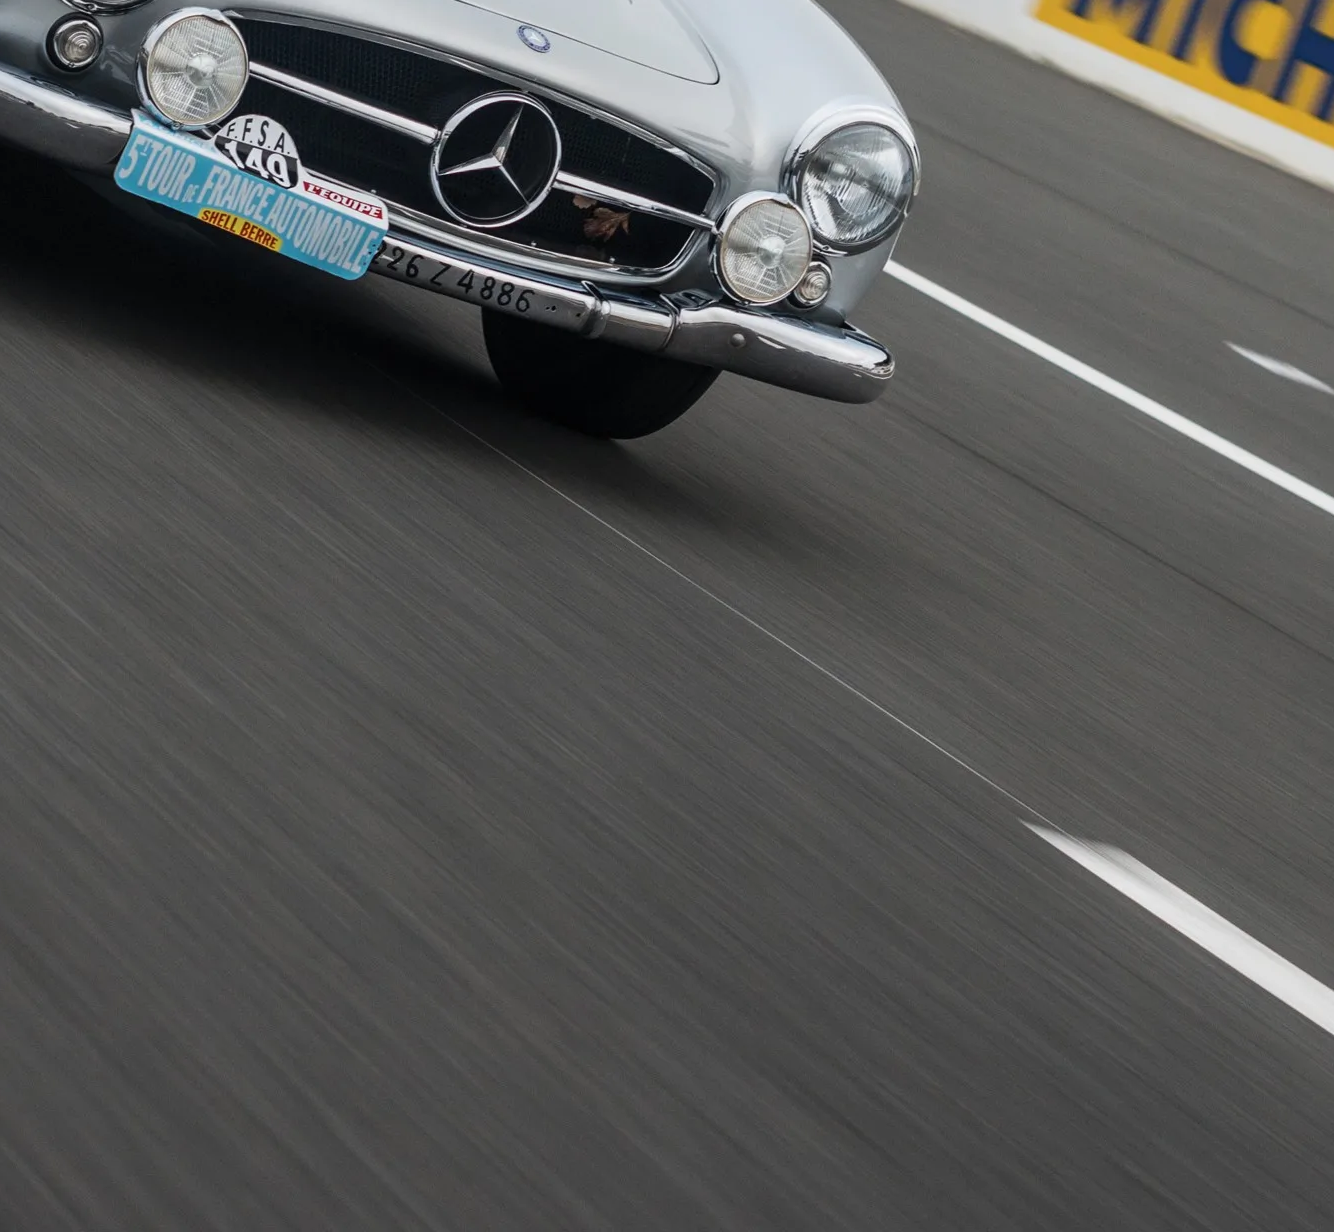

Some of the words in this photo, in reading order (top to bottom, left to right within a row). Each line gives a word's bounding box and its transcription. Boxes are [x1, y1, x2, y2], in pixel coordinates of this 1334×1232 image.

[224, 140, 292, 189] 149
[138, 141, 196, 201] TOUR
[182, 184, 199, 203] DE
[196, 165, 275, 221] FRANCE
[265, 193, 377, 274] AUTOMOBILE
[202, 210, 238, 233] SHELL
[240, 221, 278, 250] BERRE
[430, 262, 452, 286] Z
[457, 269, 536, 313] 4886
